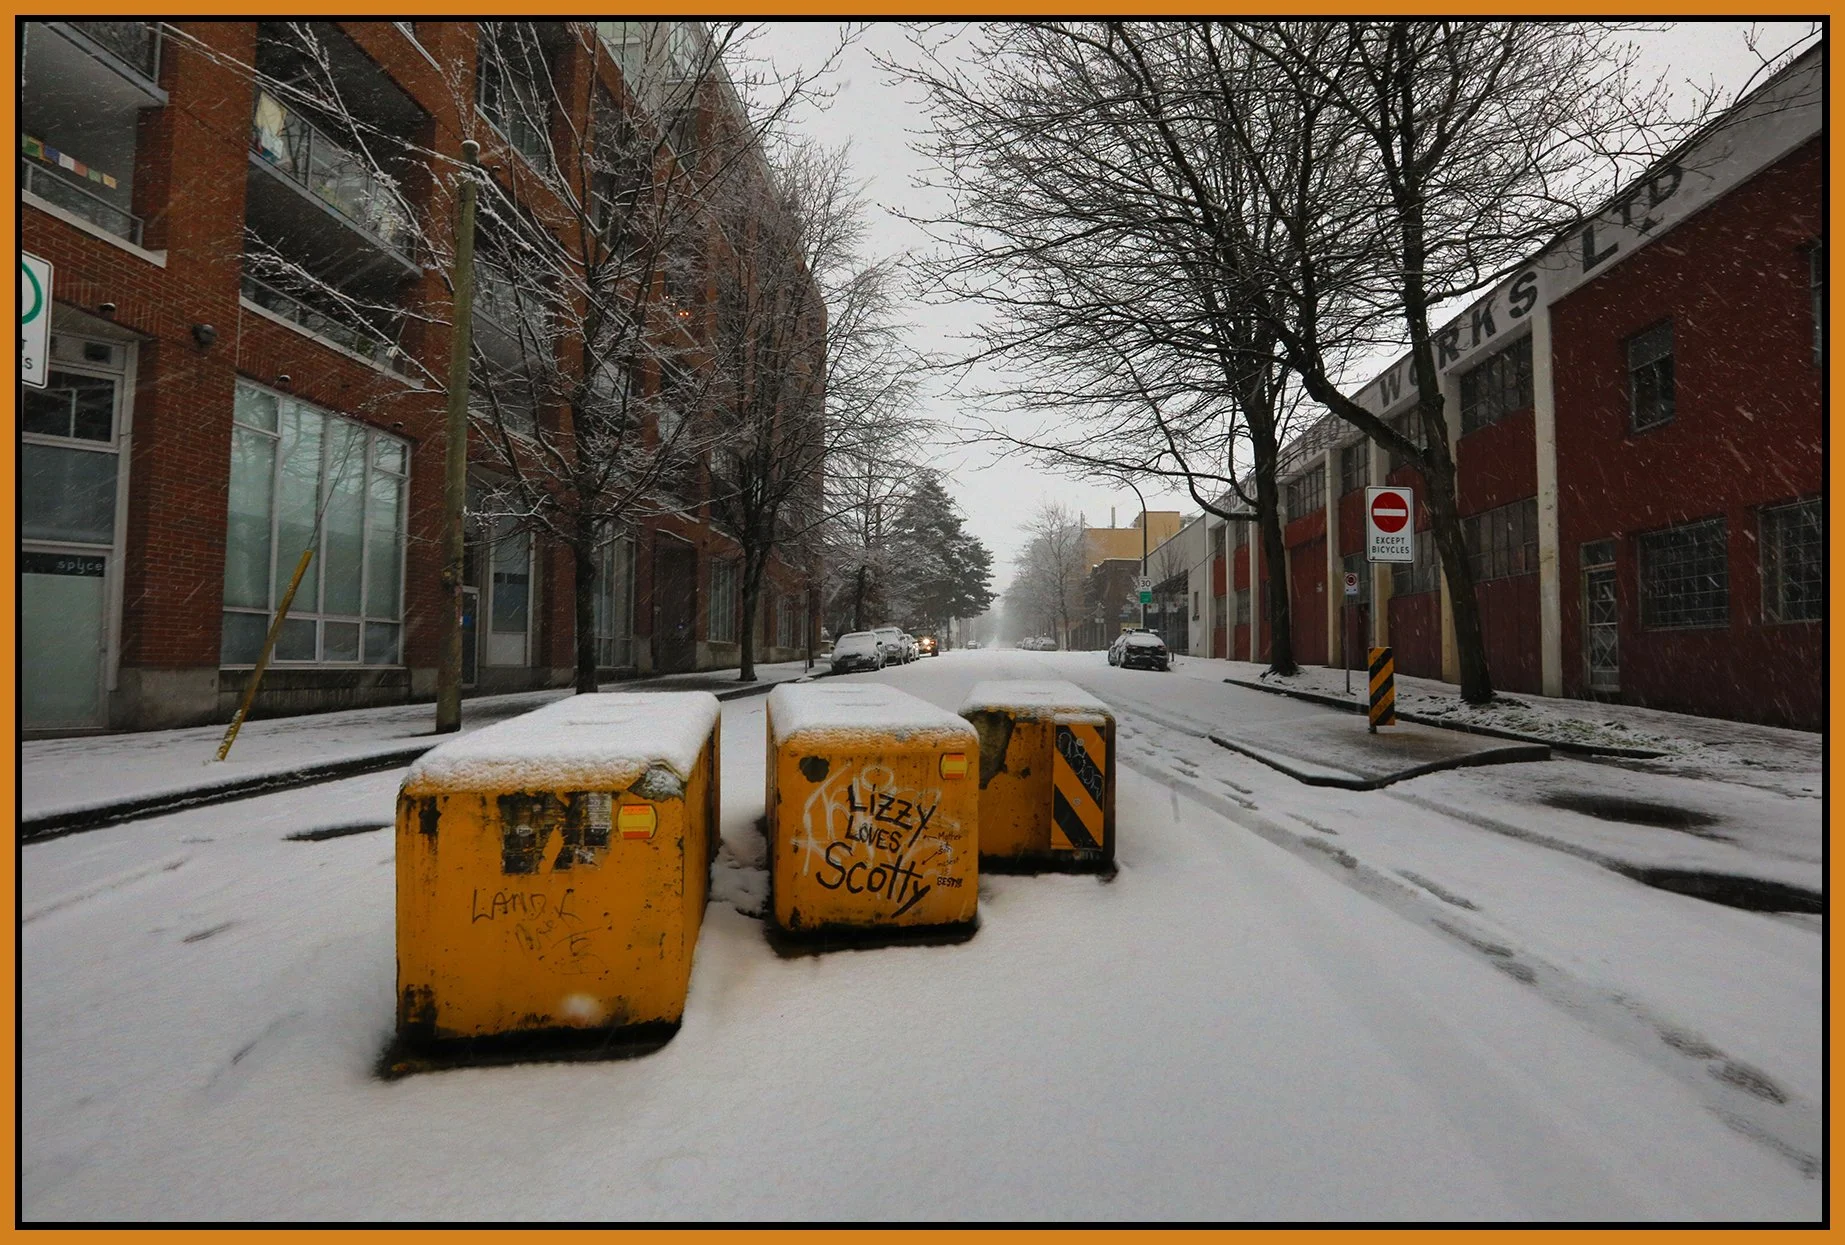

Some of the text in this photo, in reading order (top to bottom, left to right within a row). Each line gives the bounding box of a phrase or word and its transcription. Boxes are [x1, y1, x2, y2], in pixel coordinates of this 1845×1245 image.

[1375, 536, 1405, 545] EXCEPT
[1371, 545, 1410, 554] BICYCLES
[57, 557, 103, 574] spyce
[1140, 579, 1151, 588] 30
[845, 815, 902, 854] LOVES
